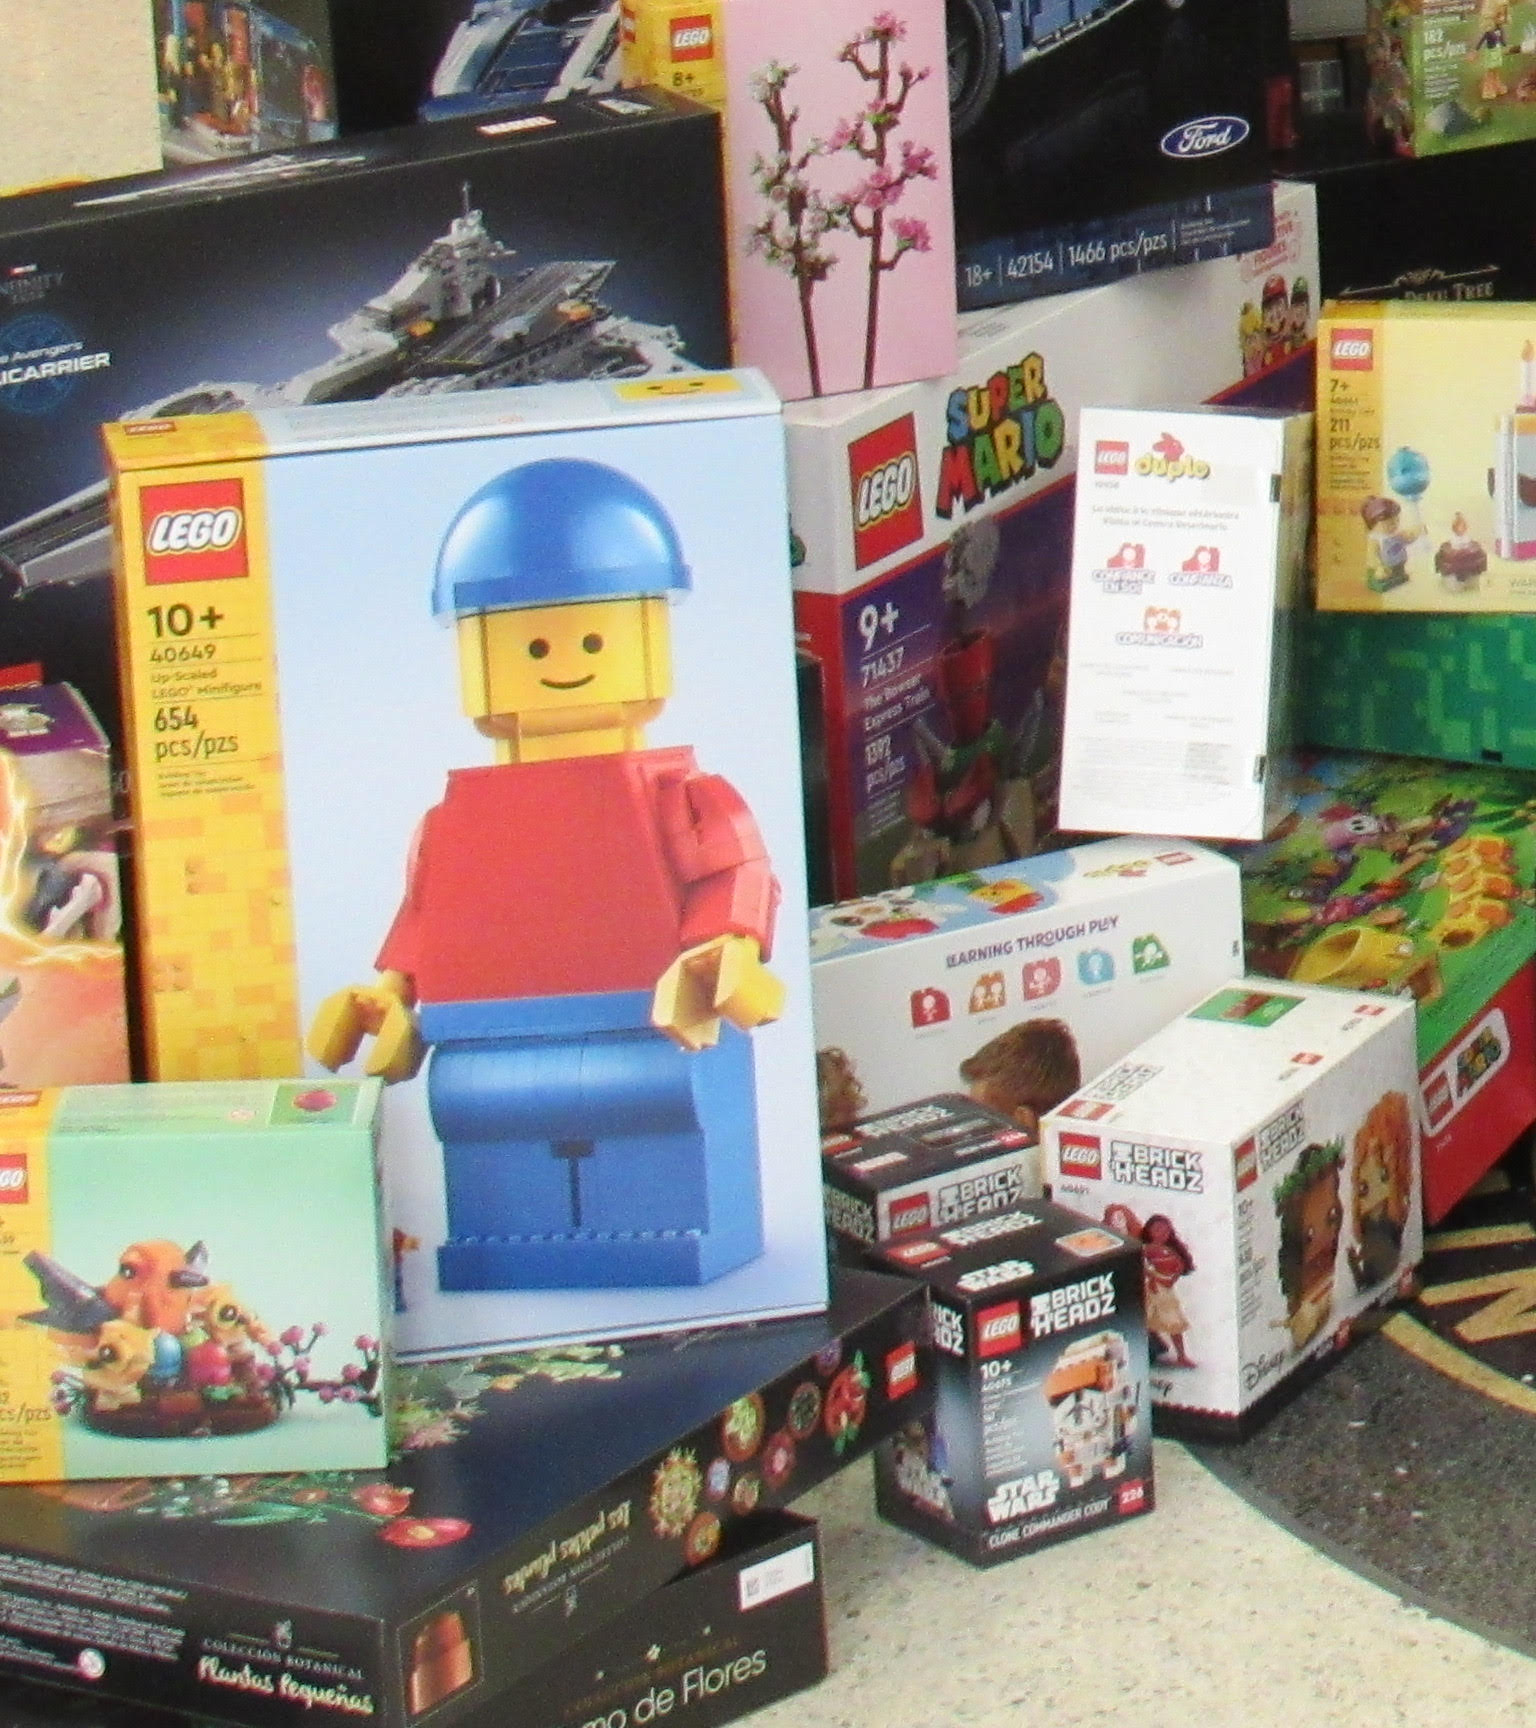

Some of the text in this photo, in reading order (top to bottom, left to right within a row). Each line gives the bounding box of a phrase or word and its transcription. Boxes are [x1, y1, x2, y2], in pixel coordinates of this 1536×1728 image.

[673, 24, 711, 48] LEGO
[1179, 121, 1232, 153] Ford
[965, 232, 1169, 288] 18+ 42154 1466 pcs/pzs
[1453, 282, 1495, 299] TREE
[12, 340, 85, 363] Avengers
[1333, 340, 1371, 358] LEGO
[0, 351, 112, 386] ICARRIER
[1330, 378, 1349, 393] 7+
[945, 350, 1048, 436] SUPER
[1330, 418, 1351, 433] 211
[1330, 433, 1381, 452] pcs/pzs
[935, 401, 1065, 520] MARIO
[1097, 448, 1127, 466] LEGO
[1134, 454, 1211, 483] duplo
[855, 457, 914, 530] LEGO
[148, 507, 241, 554] LEGO
[146, 603, 226, 641] 10+
[858, 601, 900, 652] 9+
[149, 644, 217, 664] 40649
[152, 704, 199, 733] 654
[152, 731, 240, 761] pcs/pzs
[945, 915, 1119, 970] LEARNING THROUGH PLAY
[1062, 1145, 1099, 1166] LEGO
[1133, 1141, 1202, 1170] BRICK
[960, 1168, 1023, 1203] BRICK
[1110, 1161, 1205, 1195] HEADZ
[892, 1207, 928, 1229] LEGO
[1053, 1272, 1115, 1309] BRICK
[980, 1317, 1021, 1343] LEGO
[1032, 1290, 1118, 1339] HEADZ
[980, 1358, 1013, 1379] 10+
[1244, 1348, 1286, 1392] Disney
[988, 1484, 1060, 1522] WARS
[994, 1471, 1060, 1505] STAR
[989, 1529, 1021, 1551] CLONE
[1022, 1509, 1081, 1540] COMMANDER
[198, 1654, 375, 1716] Plantas Pequeñas
[633, 1647, 768, 1722] de Flores
